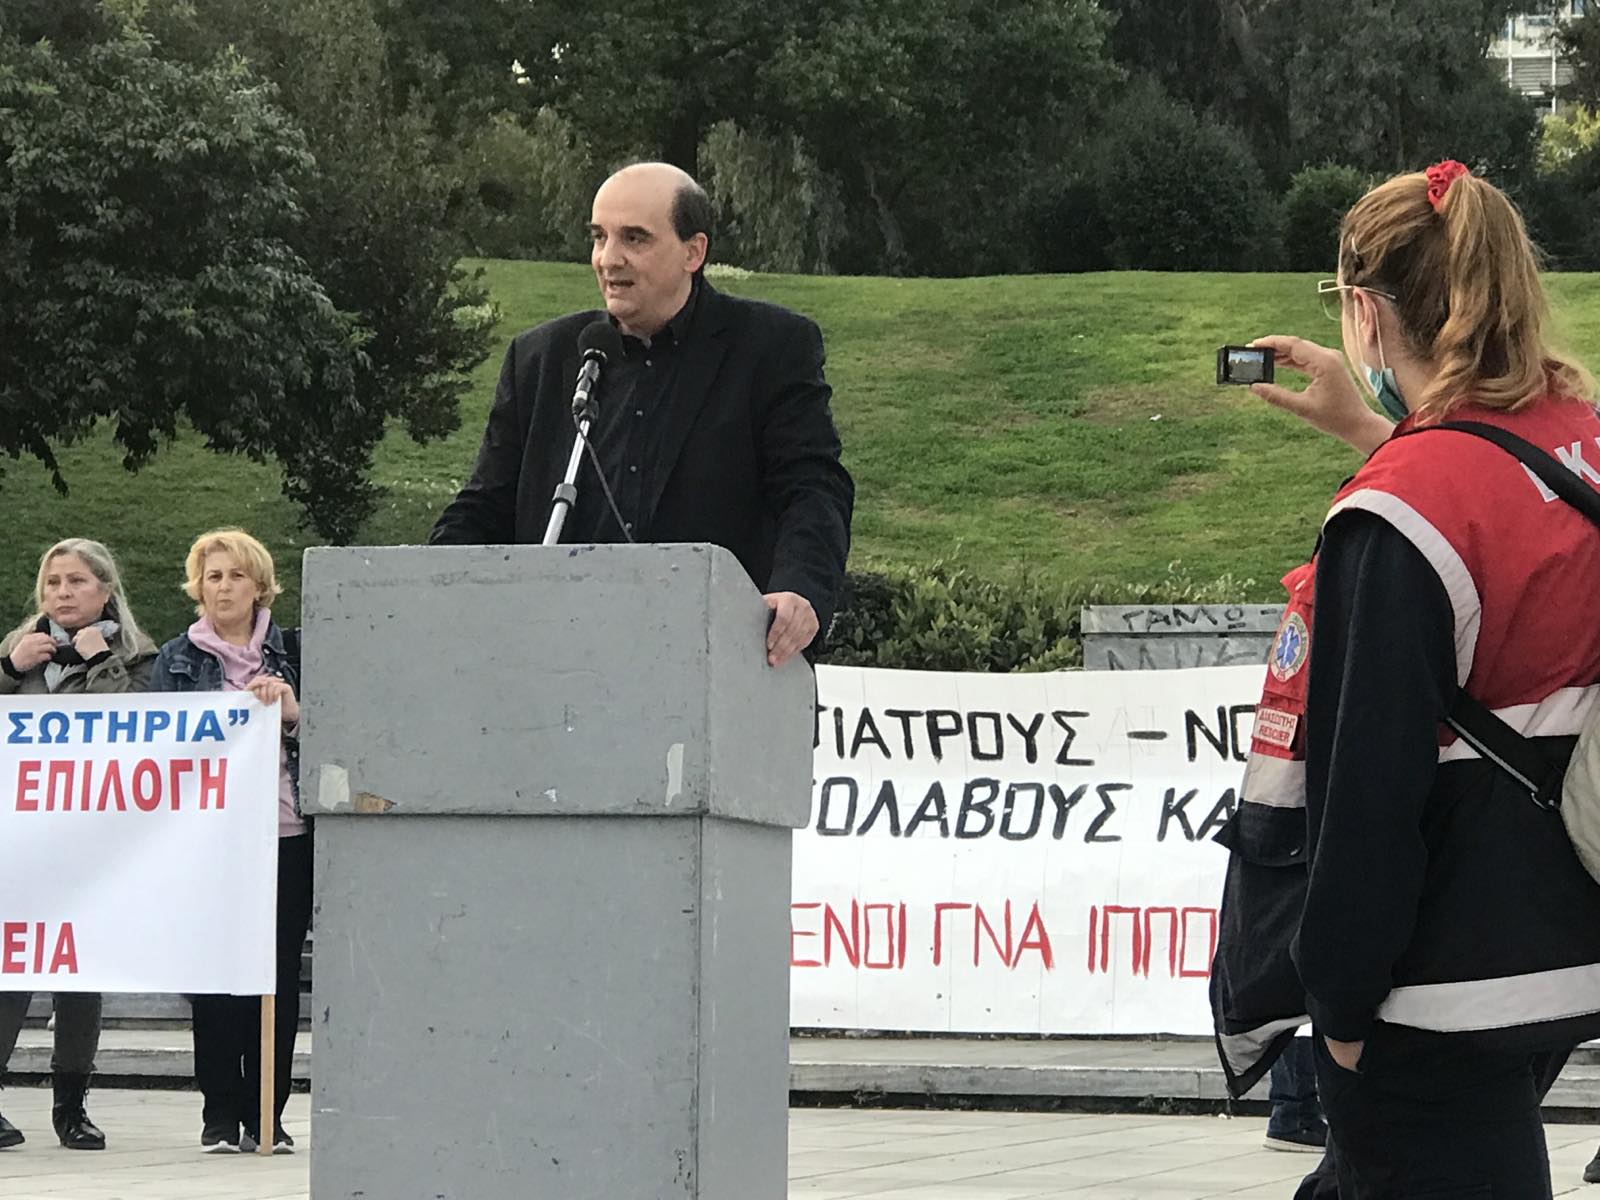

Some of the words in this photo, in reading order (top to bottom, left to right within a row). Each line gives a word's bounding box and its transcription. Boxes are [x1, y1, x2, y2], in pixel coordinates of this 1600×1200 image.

[816, 708, 1095, 766] ΙΑΤΡΟΥΣ
[15, 758, 227, 812] ΕΠΙΛΟΓΗ
[813, 777, 1133, 843] ΟΛΑΒΟΥΣ
[2, 922, 78, 974] ΕΙΑ
[933, 900, 1055, 969] ΓΝΑ
